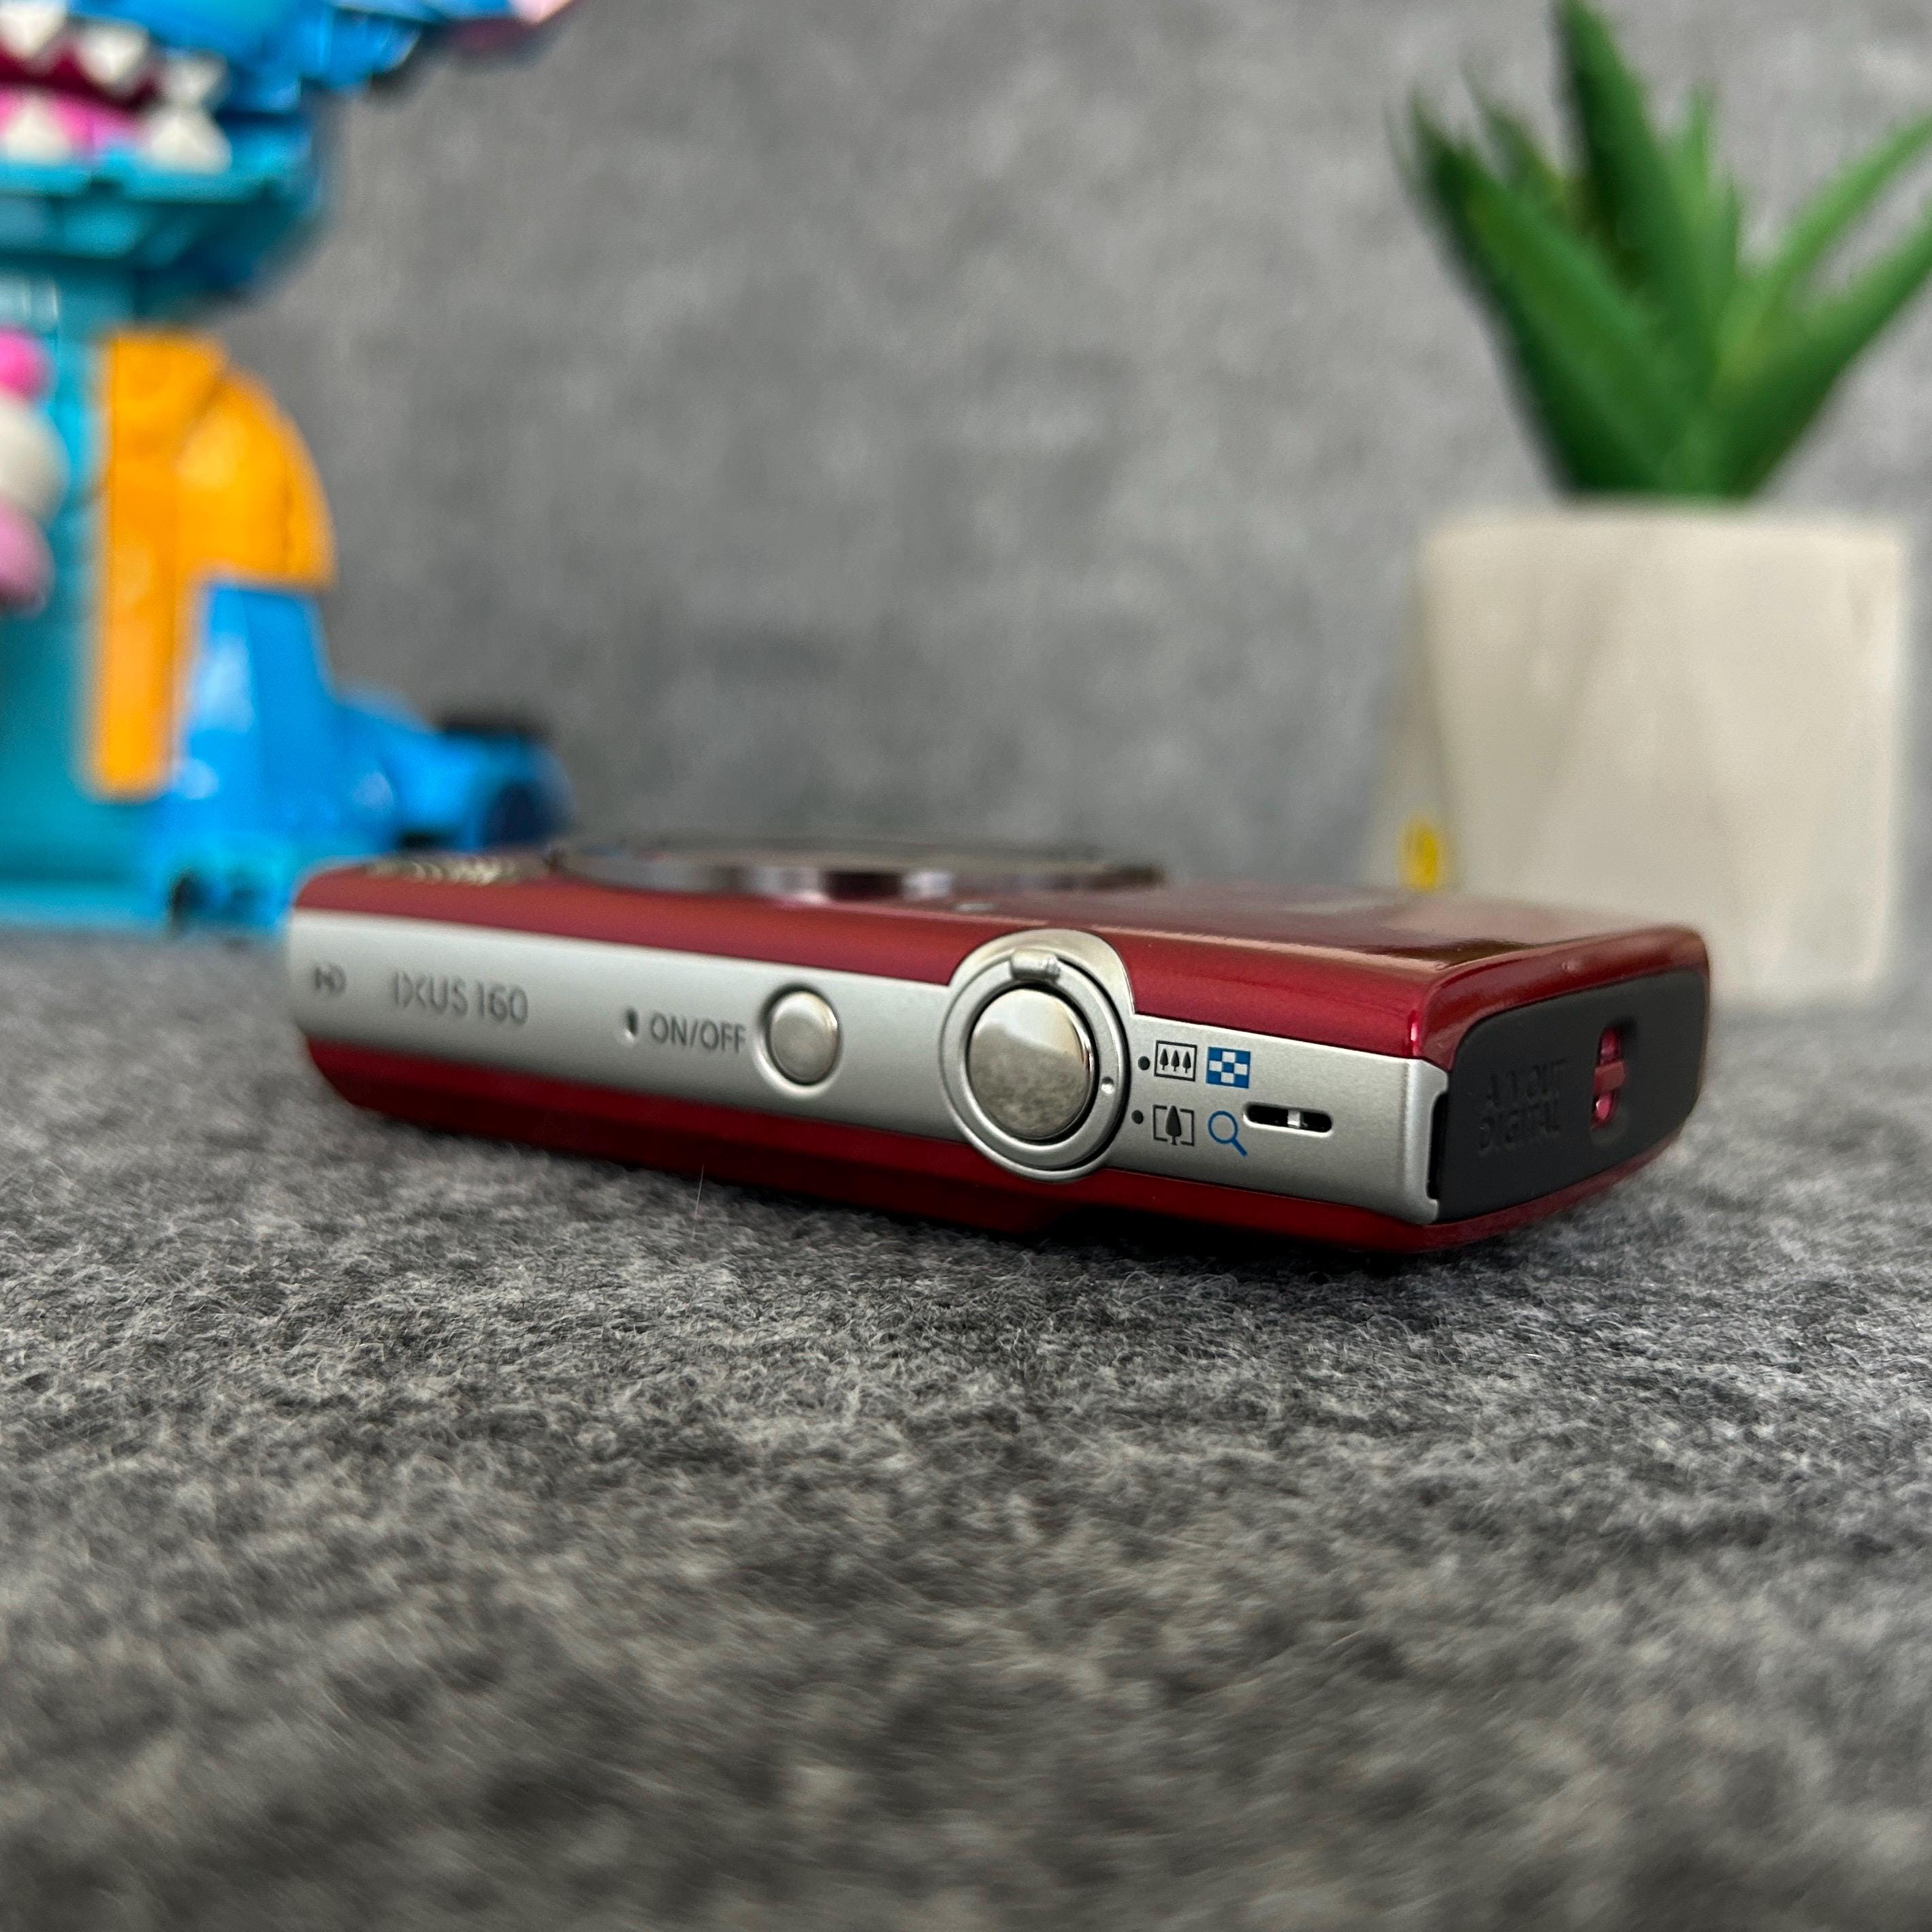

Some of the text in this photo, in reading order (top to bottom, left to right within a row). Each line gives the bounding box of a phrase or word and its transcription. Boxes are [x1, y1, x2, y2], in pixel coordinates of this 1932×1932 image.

[391, 970, 528, 1025] IXUS 160
[650, 1012, 747, 1054] ON/OFF
